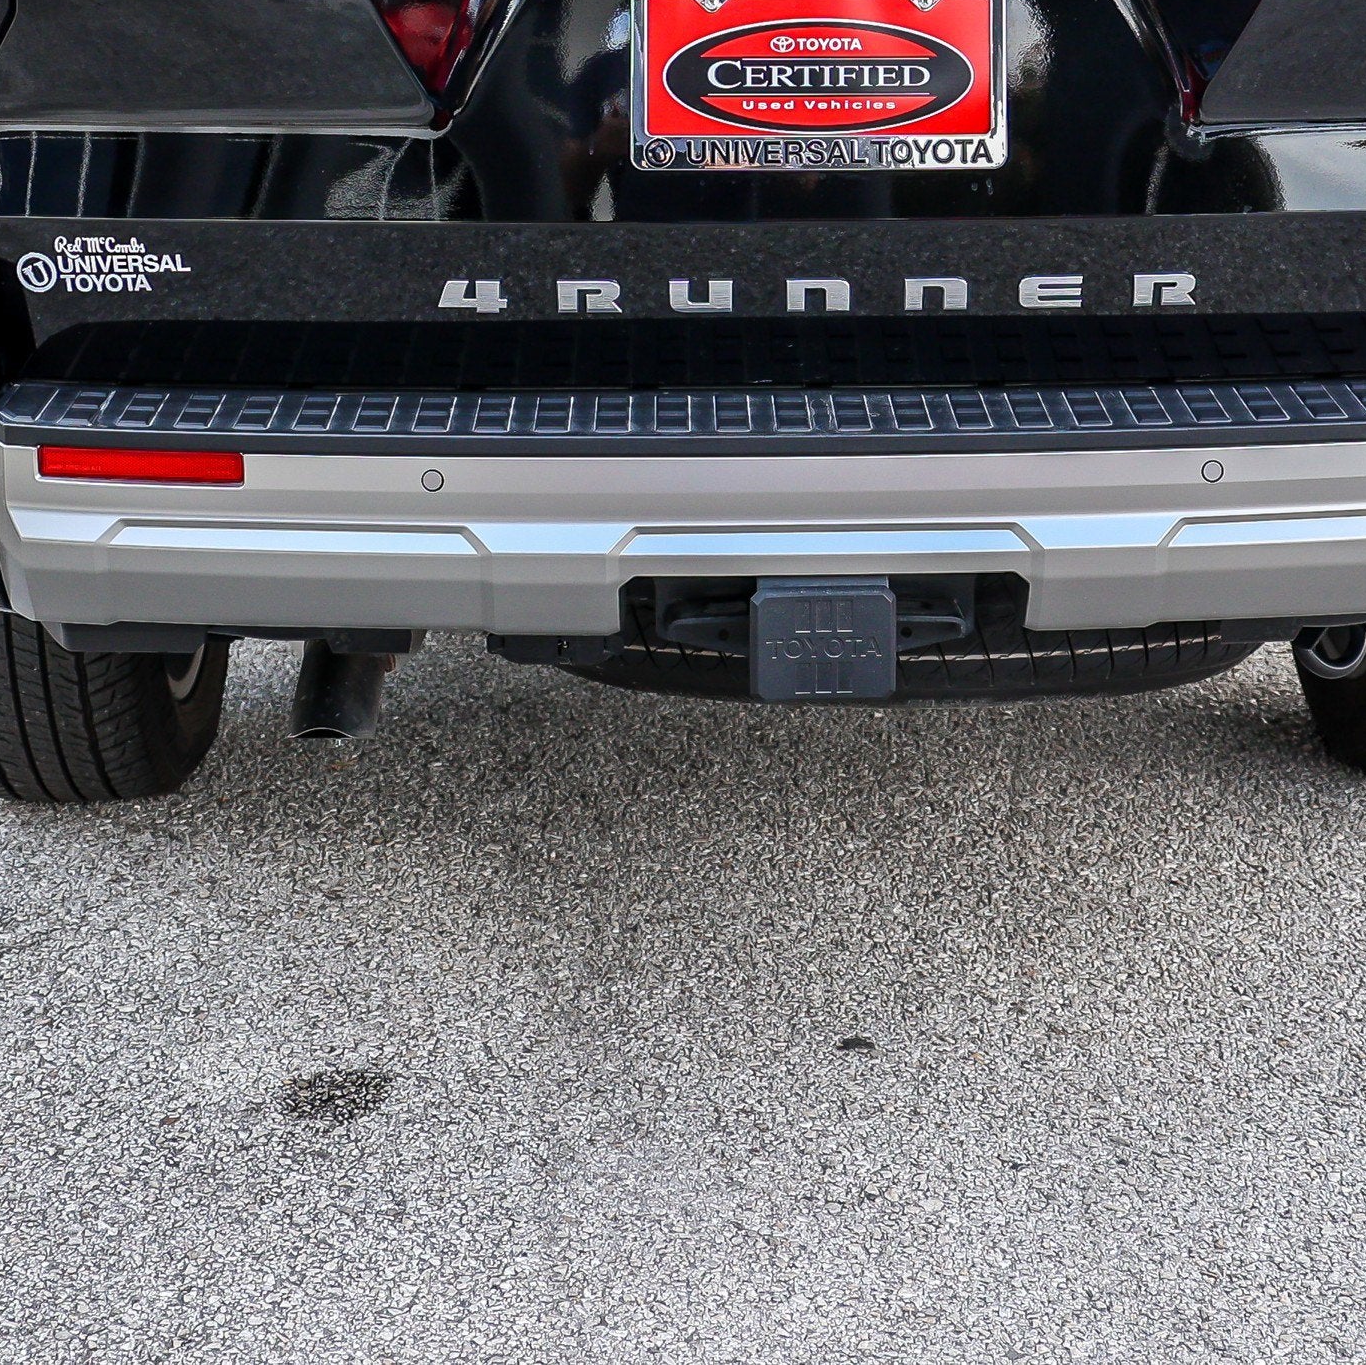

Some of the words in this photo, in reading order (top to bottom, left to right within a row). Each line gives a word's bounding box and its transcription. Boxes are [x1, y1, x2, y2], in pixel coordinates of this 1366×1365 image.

[797, 37, 863, 52] TOYOTA
[706, 59, 932, 89] CERTIFIED
[742, 99, 795, 111] Used
[804, 99, 897, 111] Vehicles
[686, 139, 868, 166] UNIVERSAL
[871, 138, 994, 164] TOYOTA
[54, 236, 81, 258] Red
[56, 253, 192, 273] UNIVERSAL
[60, 273, 152, 292] TOYOTA
[437, 273, 1198, 314] 4RUNNER
[765, 636, 883, 660] TOYOTA
